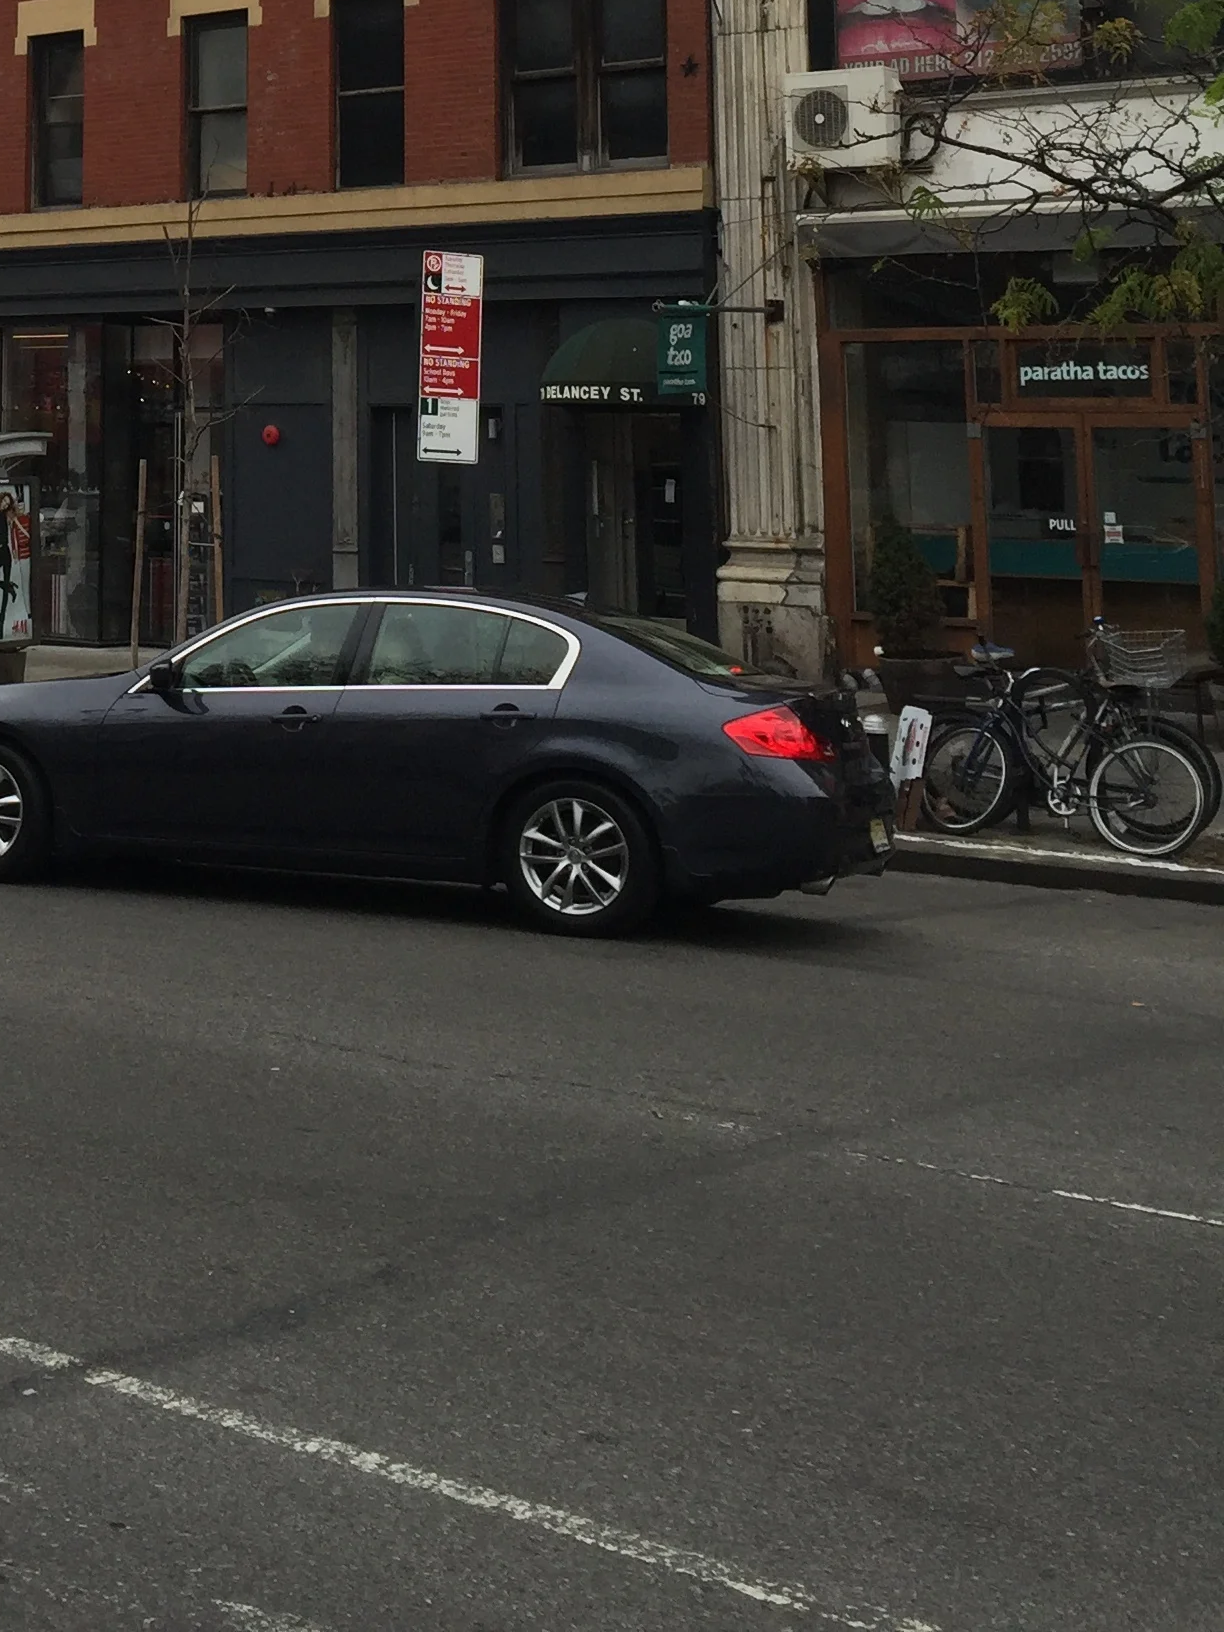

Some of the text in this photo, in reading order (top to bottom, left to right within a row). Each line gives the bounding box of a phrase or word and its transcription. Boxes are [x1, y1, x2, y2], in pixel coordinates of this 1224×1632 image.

[425, 295, 472, 307] NO STANDING
[669, 323, 693, 346] goa
[667, 345, 692, 366] taco
[423, 357, 470, 369] NO STANDING
[423, 368, 442, 376] School
[1020, 360, 1150, 387] paratha tacos
[546, 384, 612, 400] DELANCEY
[620, 387, 644, 402] ST.
[691, 392, 706, 406] 79
[426, 398, 433, 414] 1
[422, 422, 446, 431] Saturday
[1049, 518, 1077, 531] PULL
